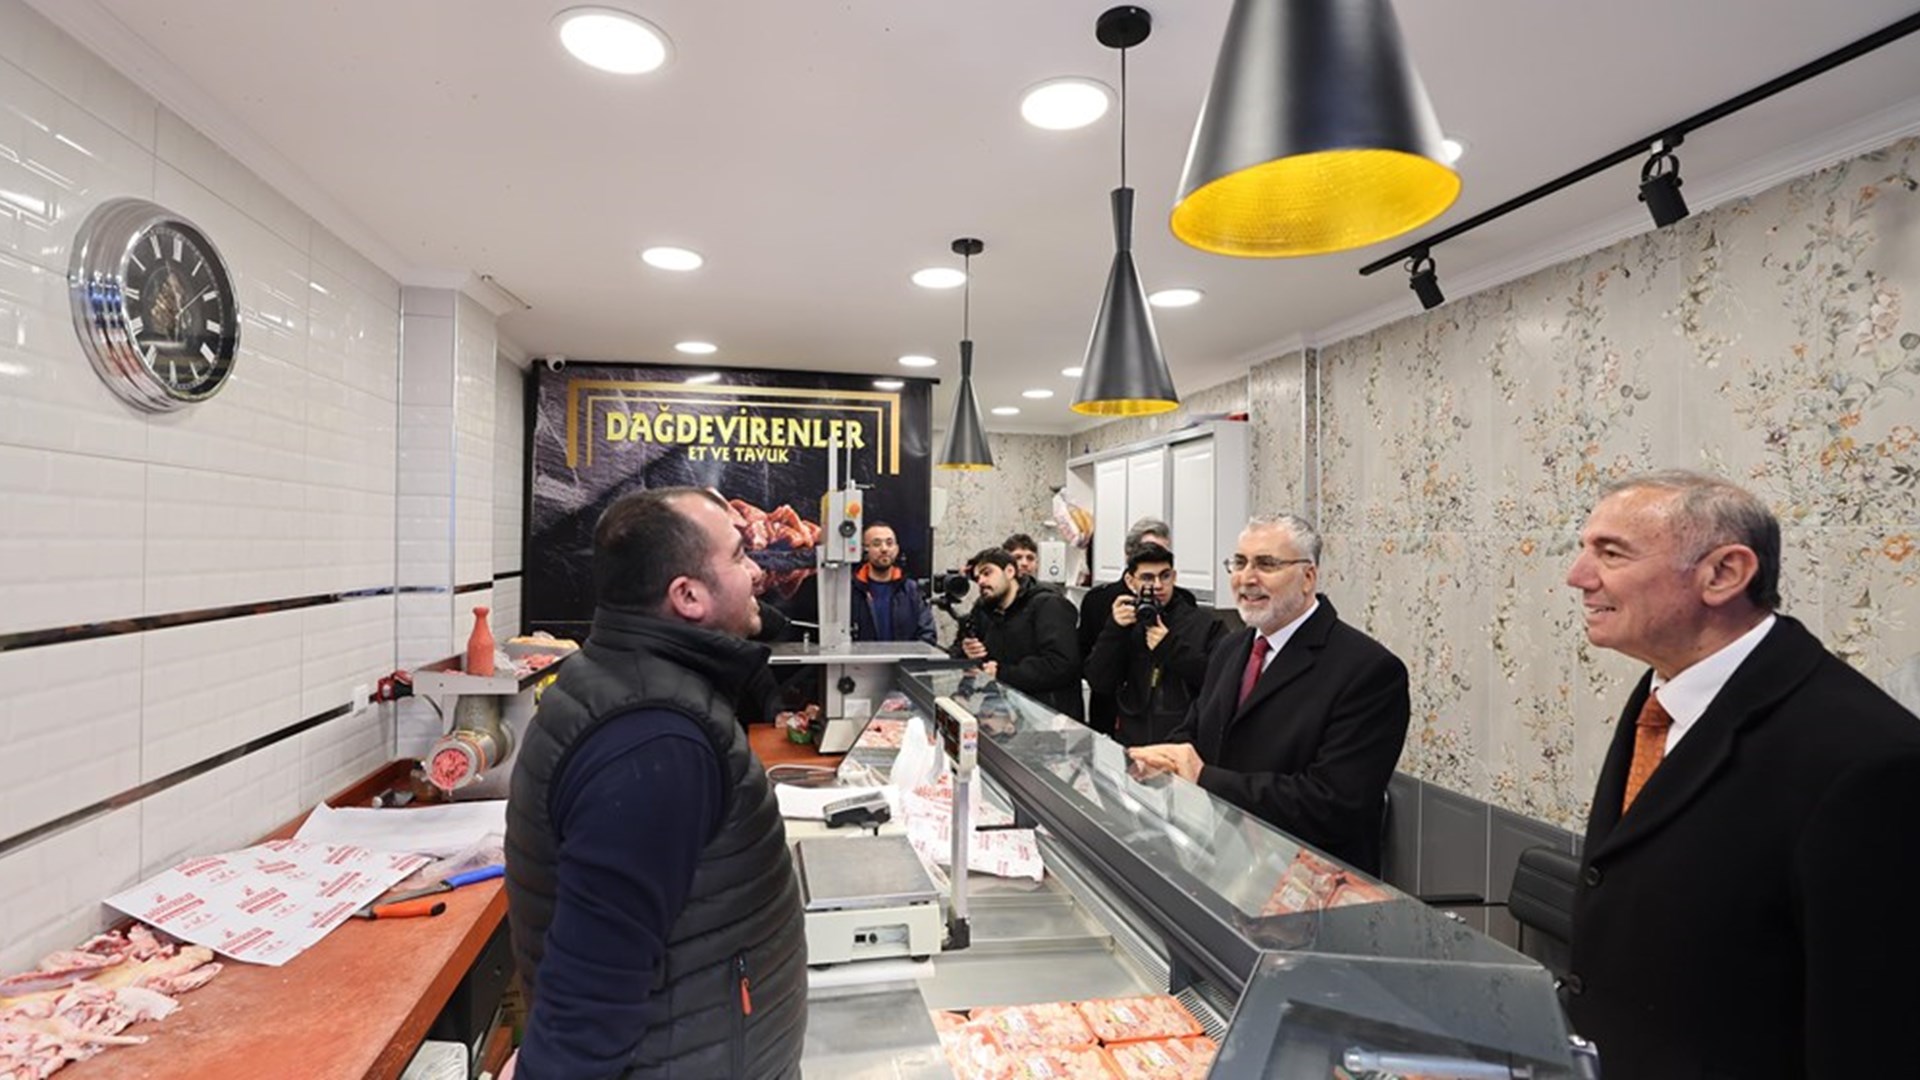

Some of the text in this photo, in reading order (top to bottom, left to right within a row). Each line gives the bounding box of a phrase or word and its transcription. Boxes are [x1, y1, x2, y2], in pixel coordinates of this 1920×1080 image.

[606, 404, 865, 449] DAĞDEVİRENLER
[688, 446, 789, 463] ET VE TAVUK
